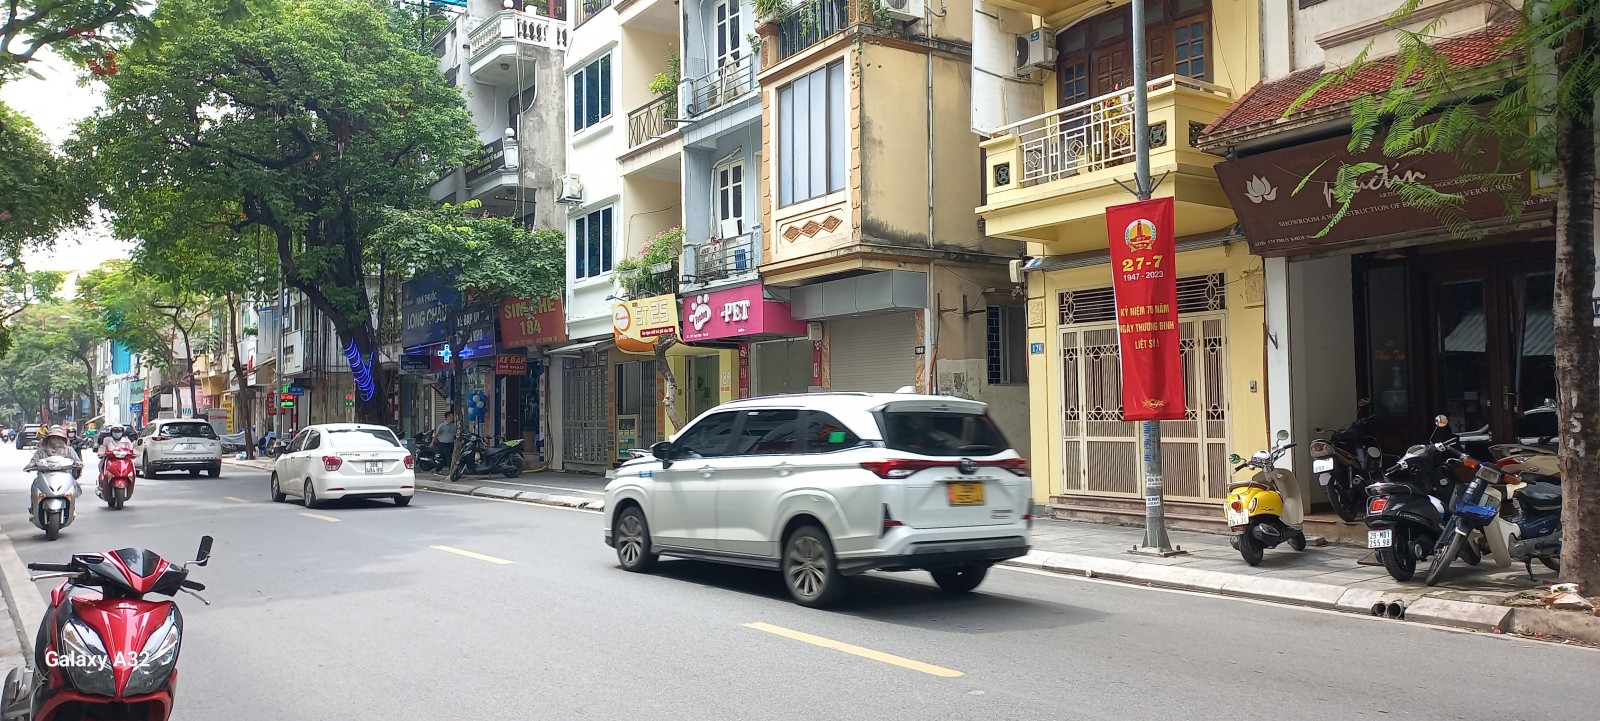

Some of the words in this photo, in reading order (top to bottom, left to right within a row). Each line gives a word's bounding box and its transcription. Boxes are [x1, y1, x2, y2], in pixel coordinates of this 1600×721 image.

[1278, 215, 1320, 227] SHOWROOM
[1122, 254, 1163, 272] 27-7
[1123, 273, 1140, 282] 1947
[1145, 270, 1164, 279] 2023
[1130, 305, 1145, 318] NIỆM
[1154, 303, 1170, 314] NĂM
[407, 310, 426, 330] LONG
[520, 320, 542, 336] 184
[1032, 344, 1043, 353] 176
